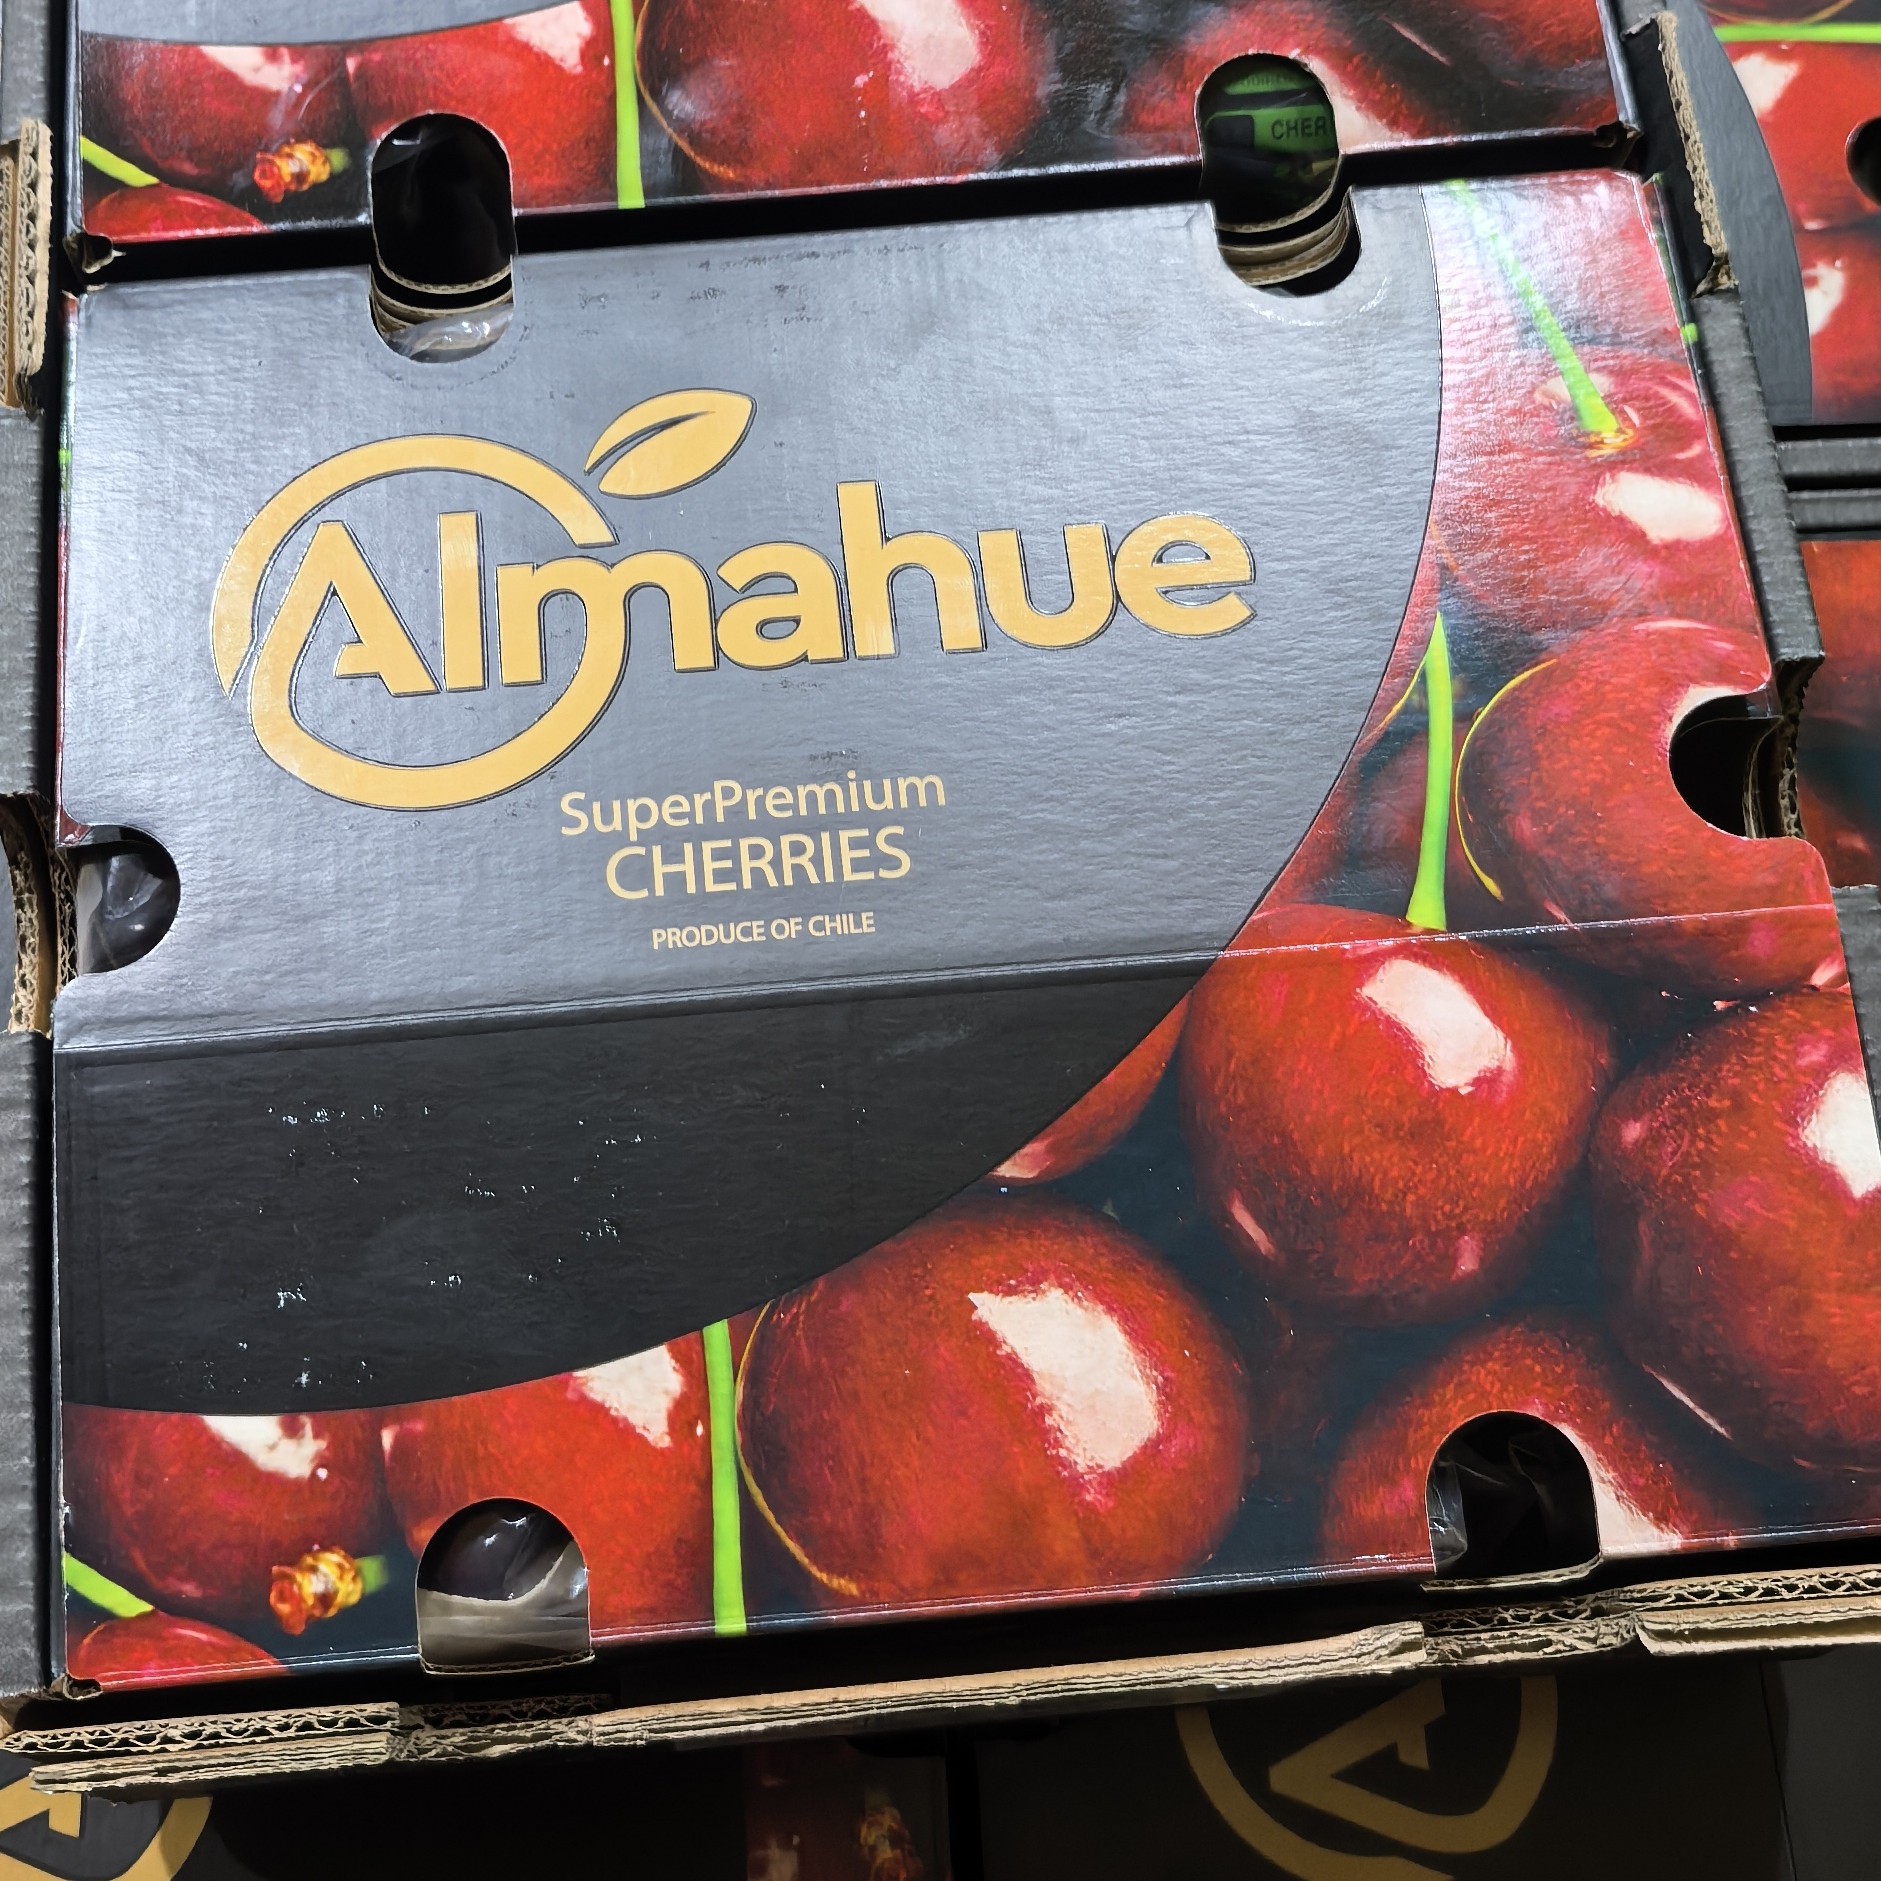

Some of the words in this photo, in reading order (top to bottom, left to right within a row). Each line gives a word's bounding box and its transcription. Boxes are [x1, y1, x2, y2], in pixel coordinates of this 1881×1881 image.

[1271, 115, 1333, 141] CHER
[247, 480, 1254, 811] Almahue
[560, 770, 946, 842] SuperPremium
[605, 825, 911, 900] CHERRIES
[651, 919, 767, 951] PRODUCE
[770, 916, 803, 940] OF
[808, 911, 876, 937] CHILE
